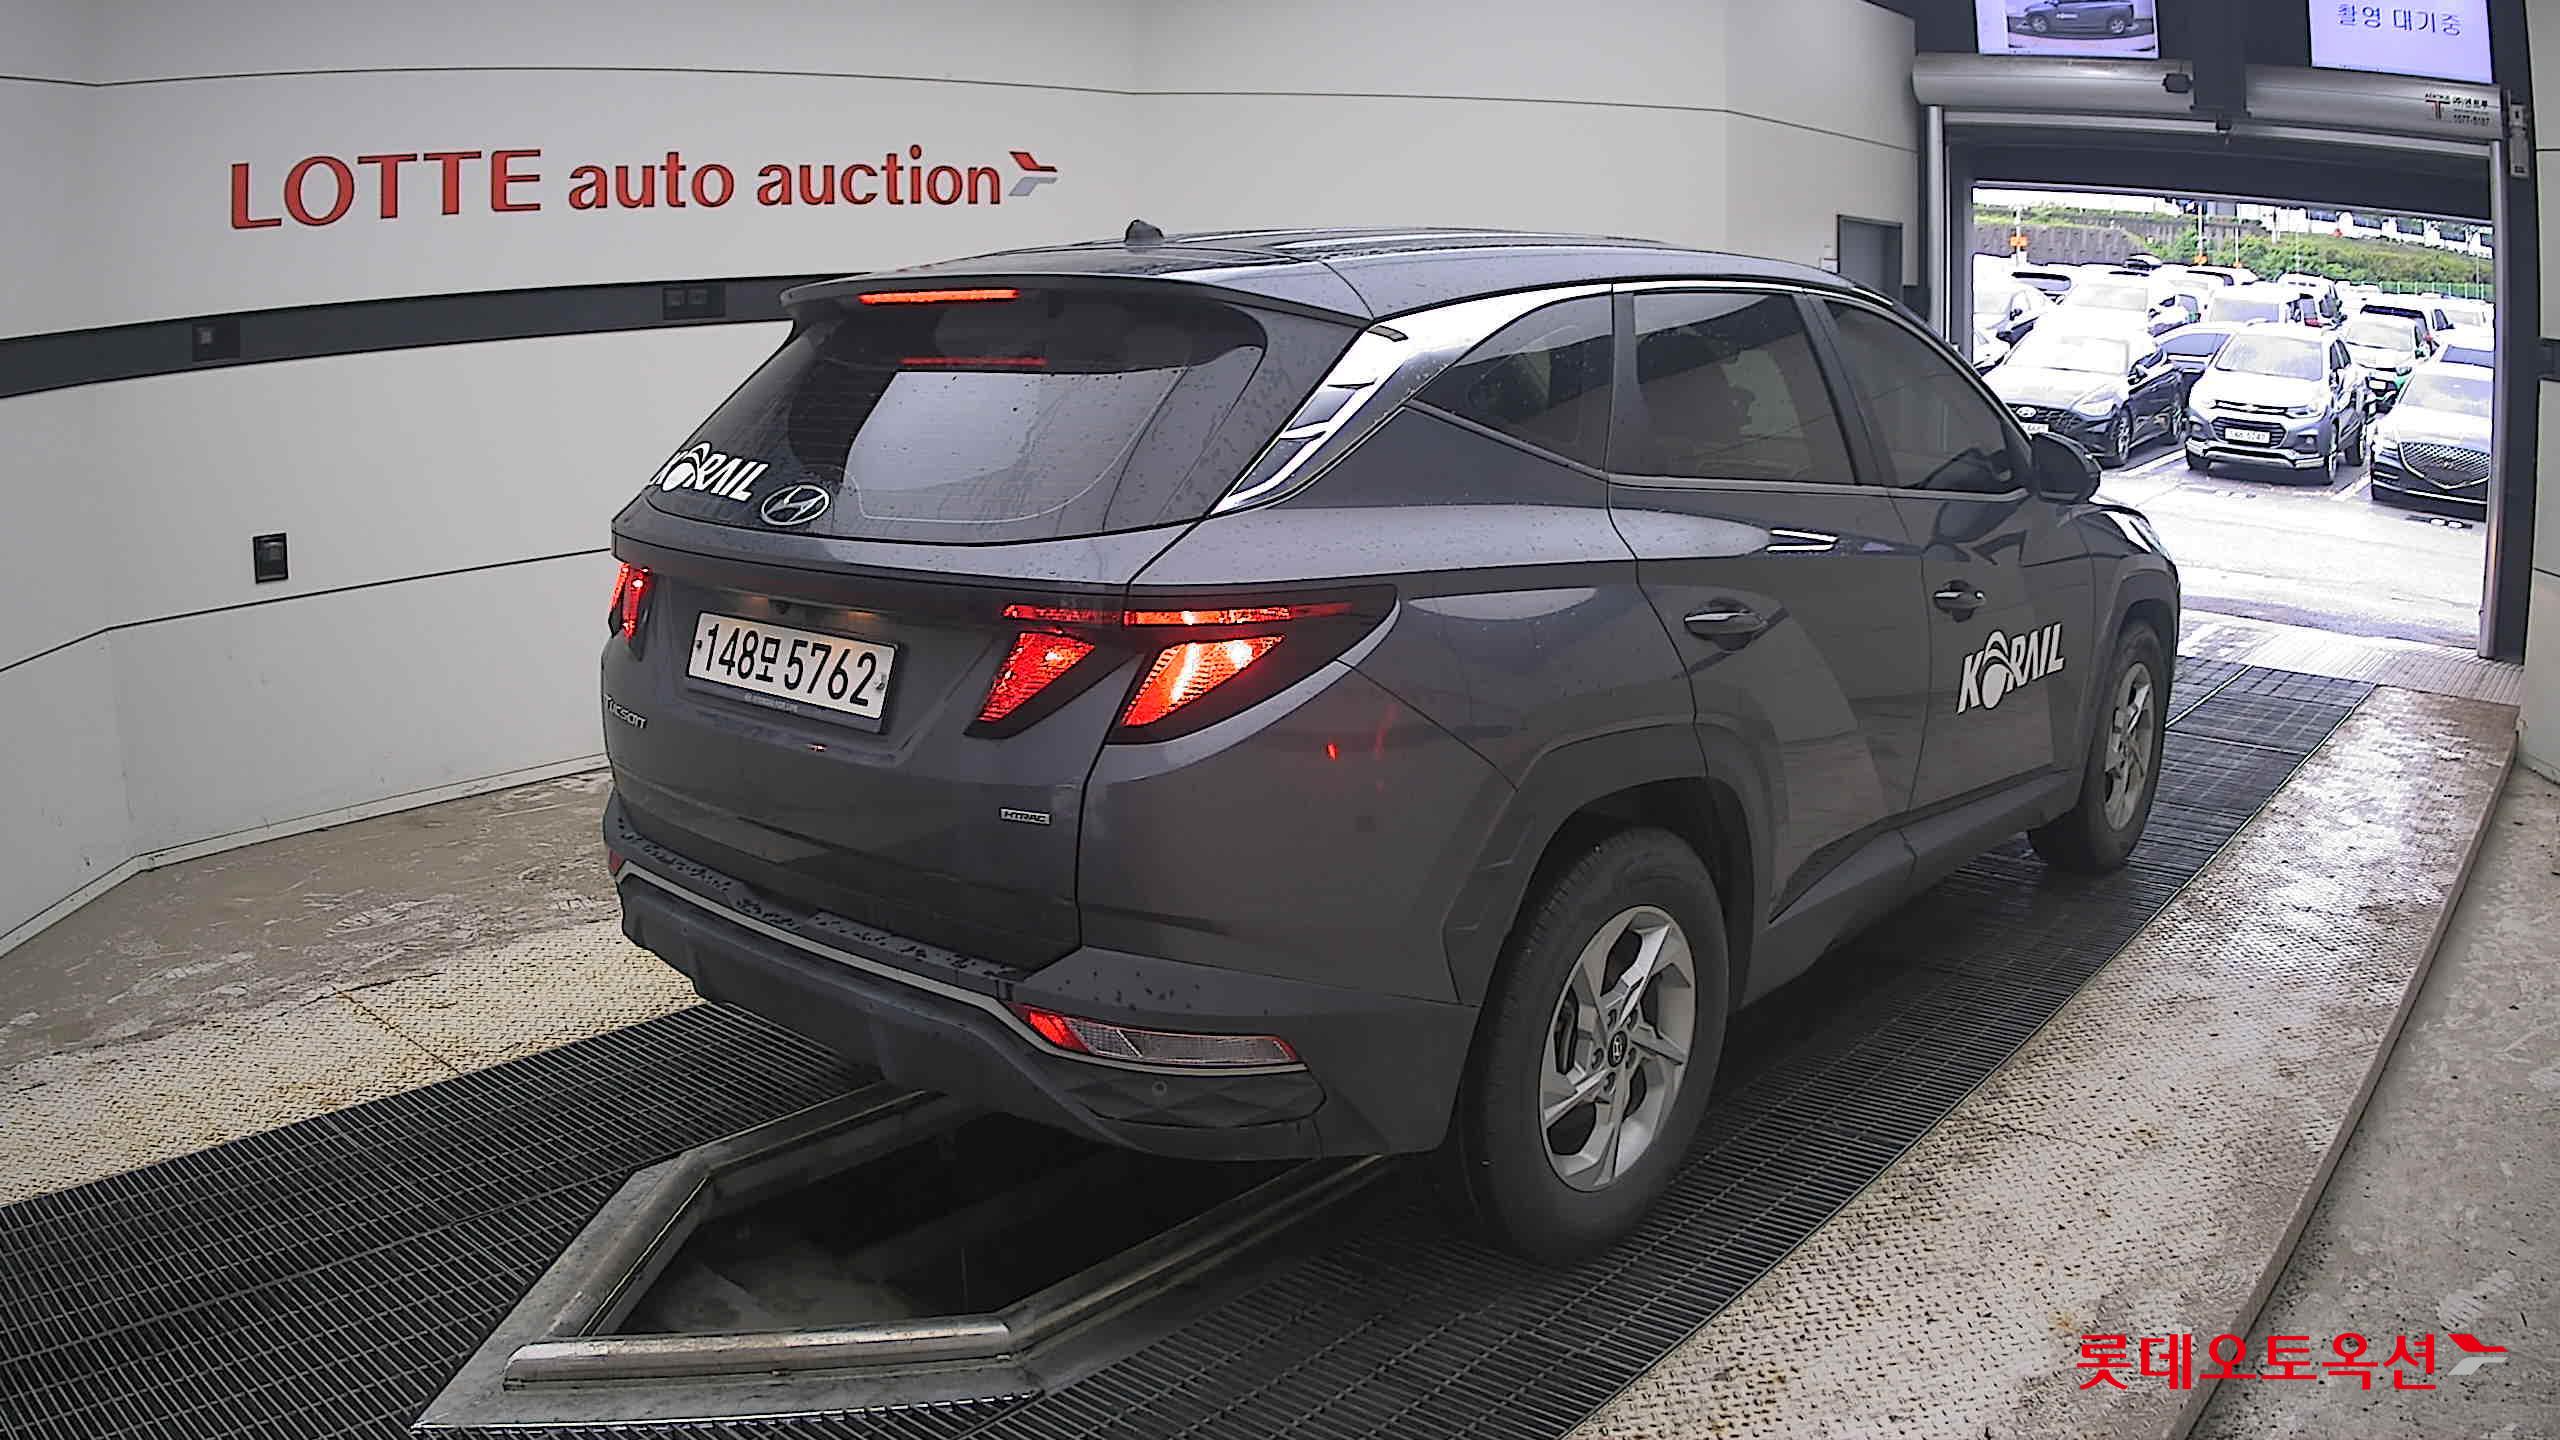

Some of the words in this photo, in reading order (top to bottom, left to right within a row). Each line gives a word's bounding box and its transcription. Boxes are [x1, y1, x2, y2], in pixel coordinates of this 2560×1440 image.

[2393, 9, 2461, 36] 대기중
[231, 149, 541, 229] LOTTE
[568, 151, 734, 209] auto
[757, 144, 1001, 208] auction
[650, 441, 770, 502] KORAIL
[784, 639, 876, 707] 5762
[1957, 622, 2065, 713] KORAIL
